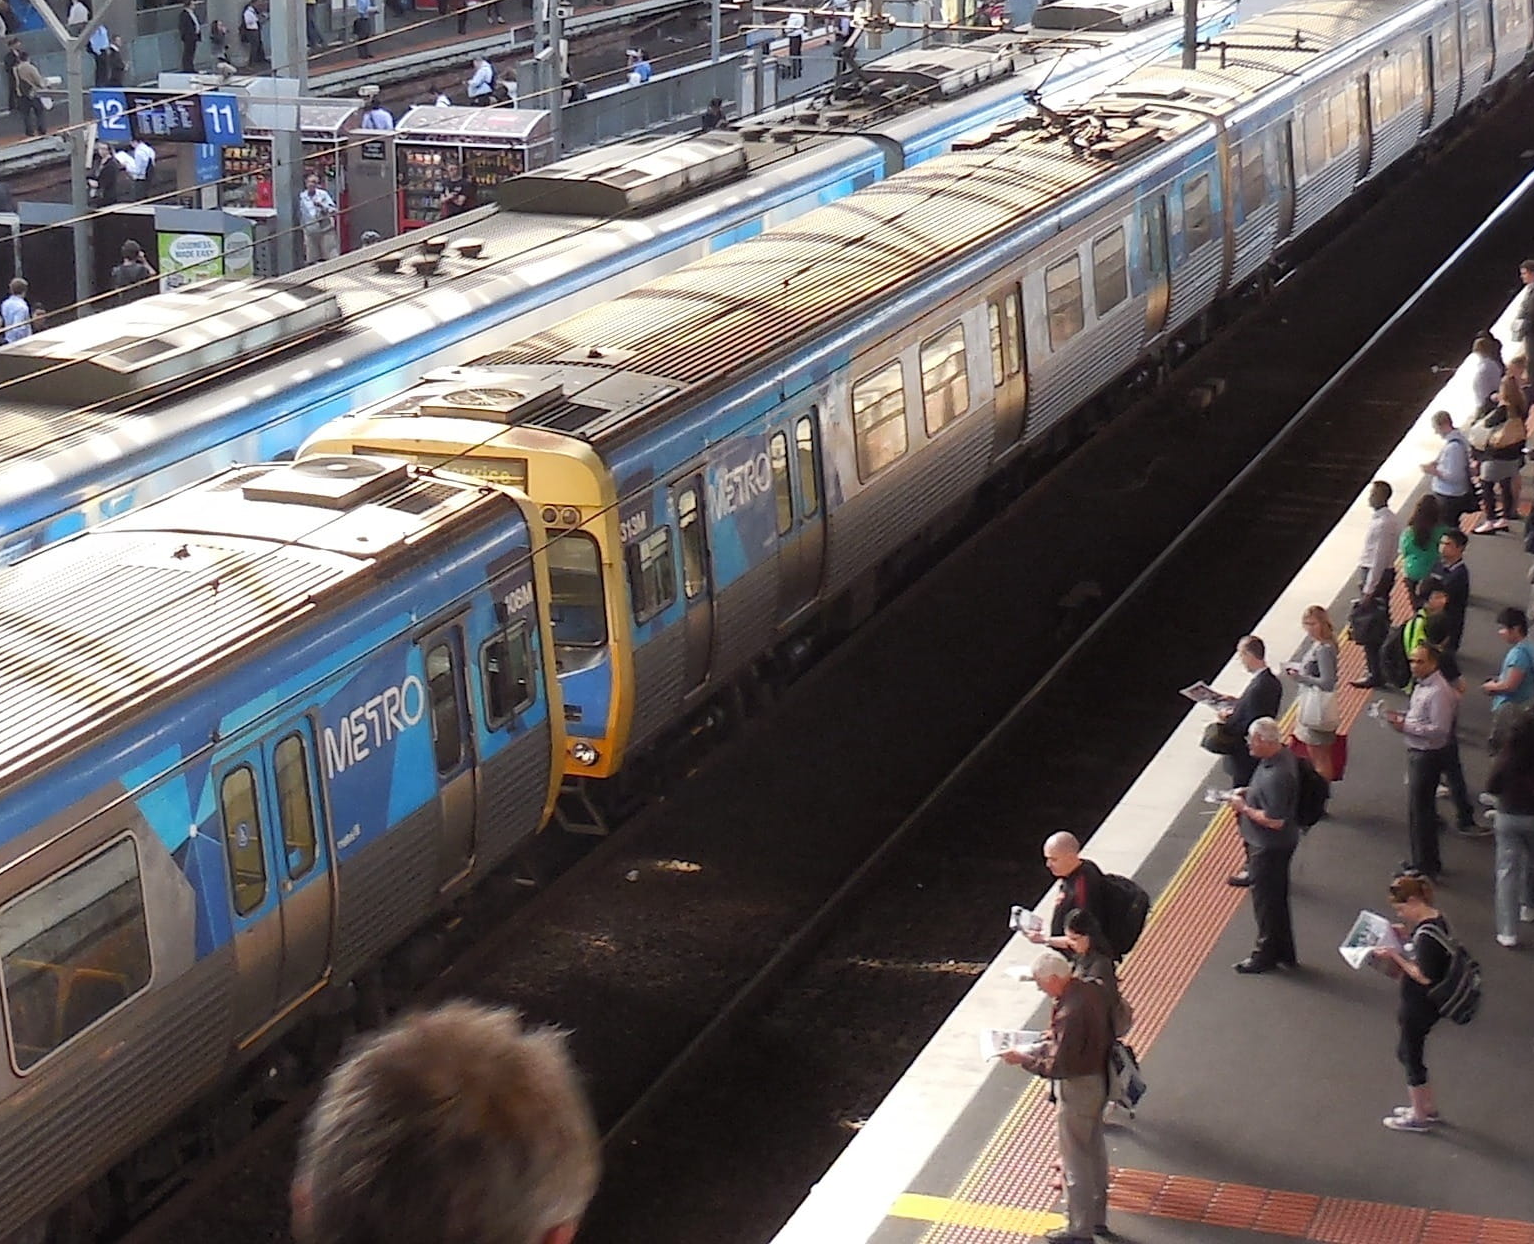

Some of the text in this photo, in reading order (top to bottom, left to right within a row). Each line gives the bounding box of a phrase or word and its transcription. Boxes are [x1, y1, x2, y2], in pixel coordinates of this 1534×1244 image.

[93, 99, 127, 130] 12
[205, 103, 235, 134] 11
[706, 453, 772, 524] METRO
[323, 675, 425, 780] METRO
